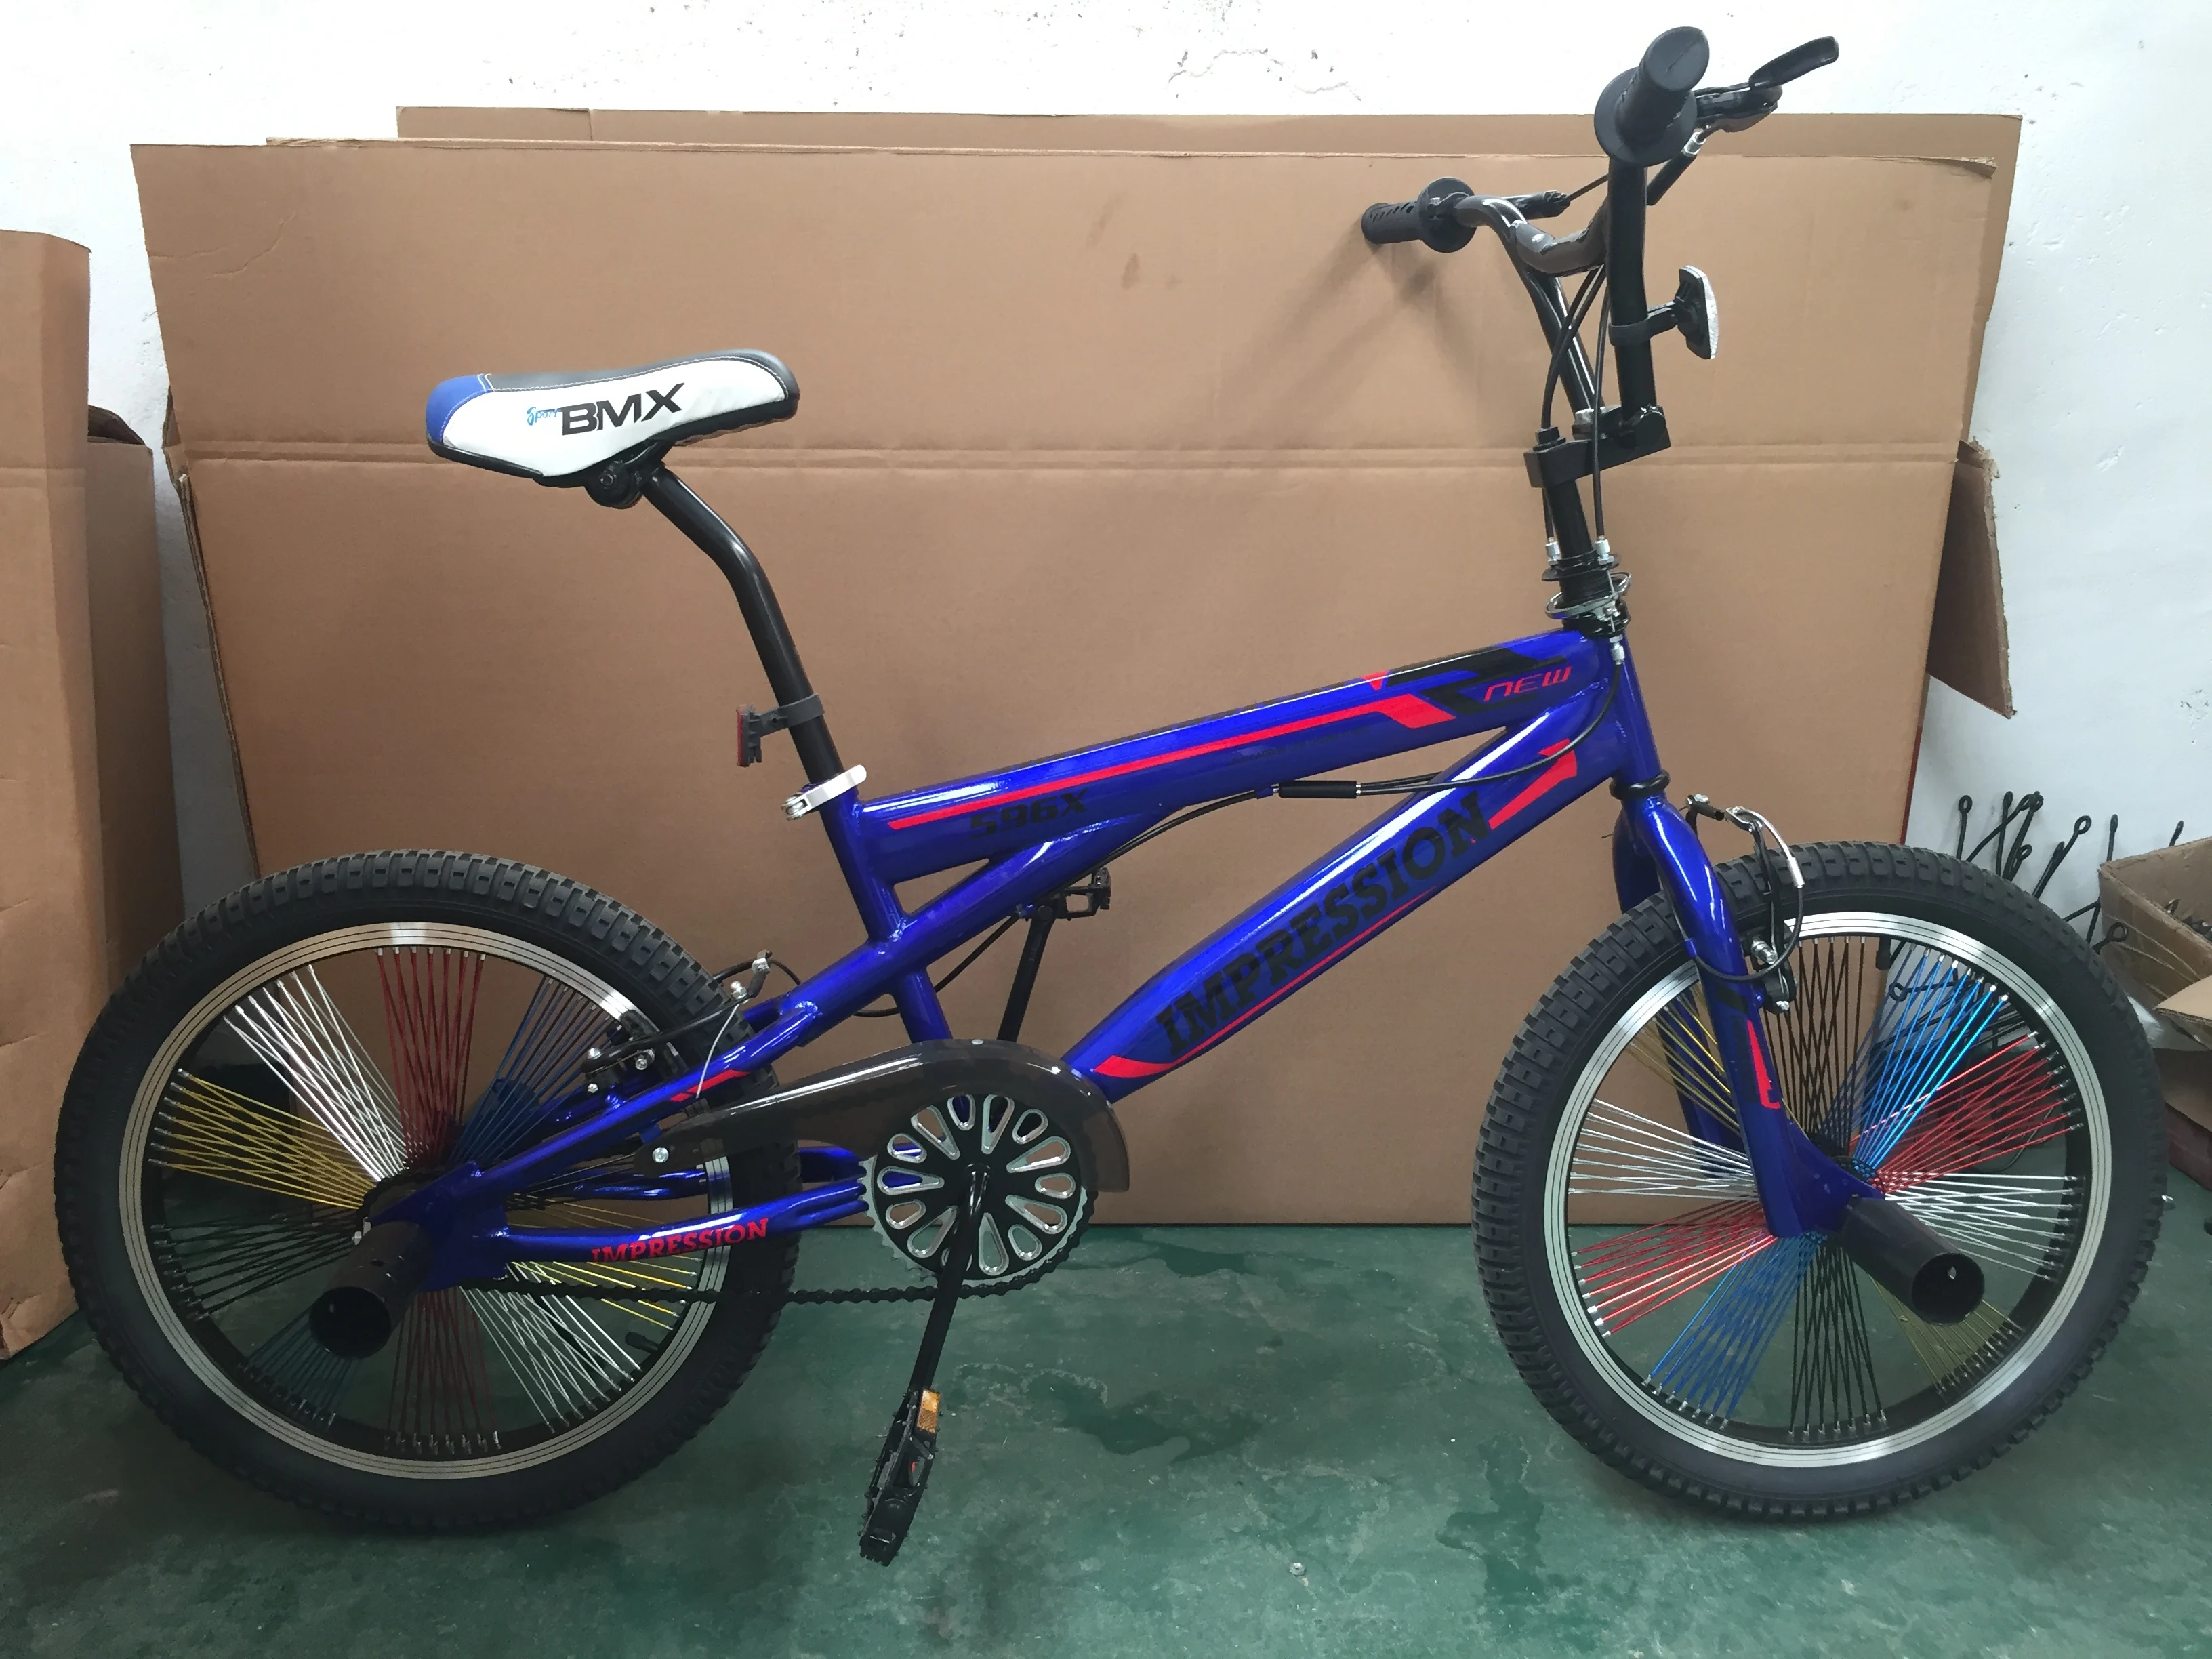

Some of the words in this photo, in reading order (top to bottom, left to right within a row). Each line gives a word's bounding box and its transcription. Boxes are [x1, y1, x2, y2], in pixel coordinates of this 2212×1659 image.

[562, 383, 684, 435] BMX
[970, 787, 1088, 839] 596X
[1155, 791, 1491, 1057] IMPRESSION
[592, 1218, 769, 1262] IMPRESSION
